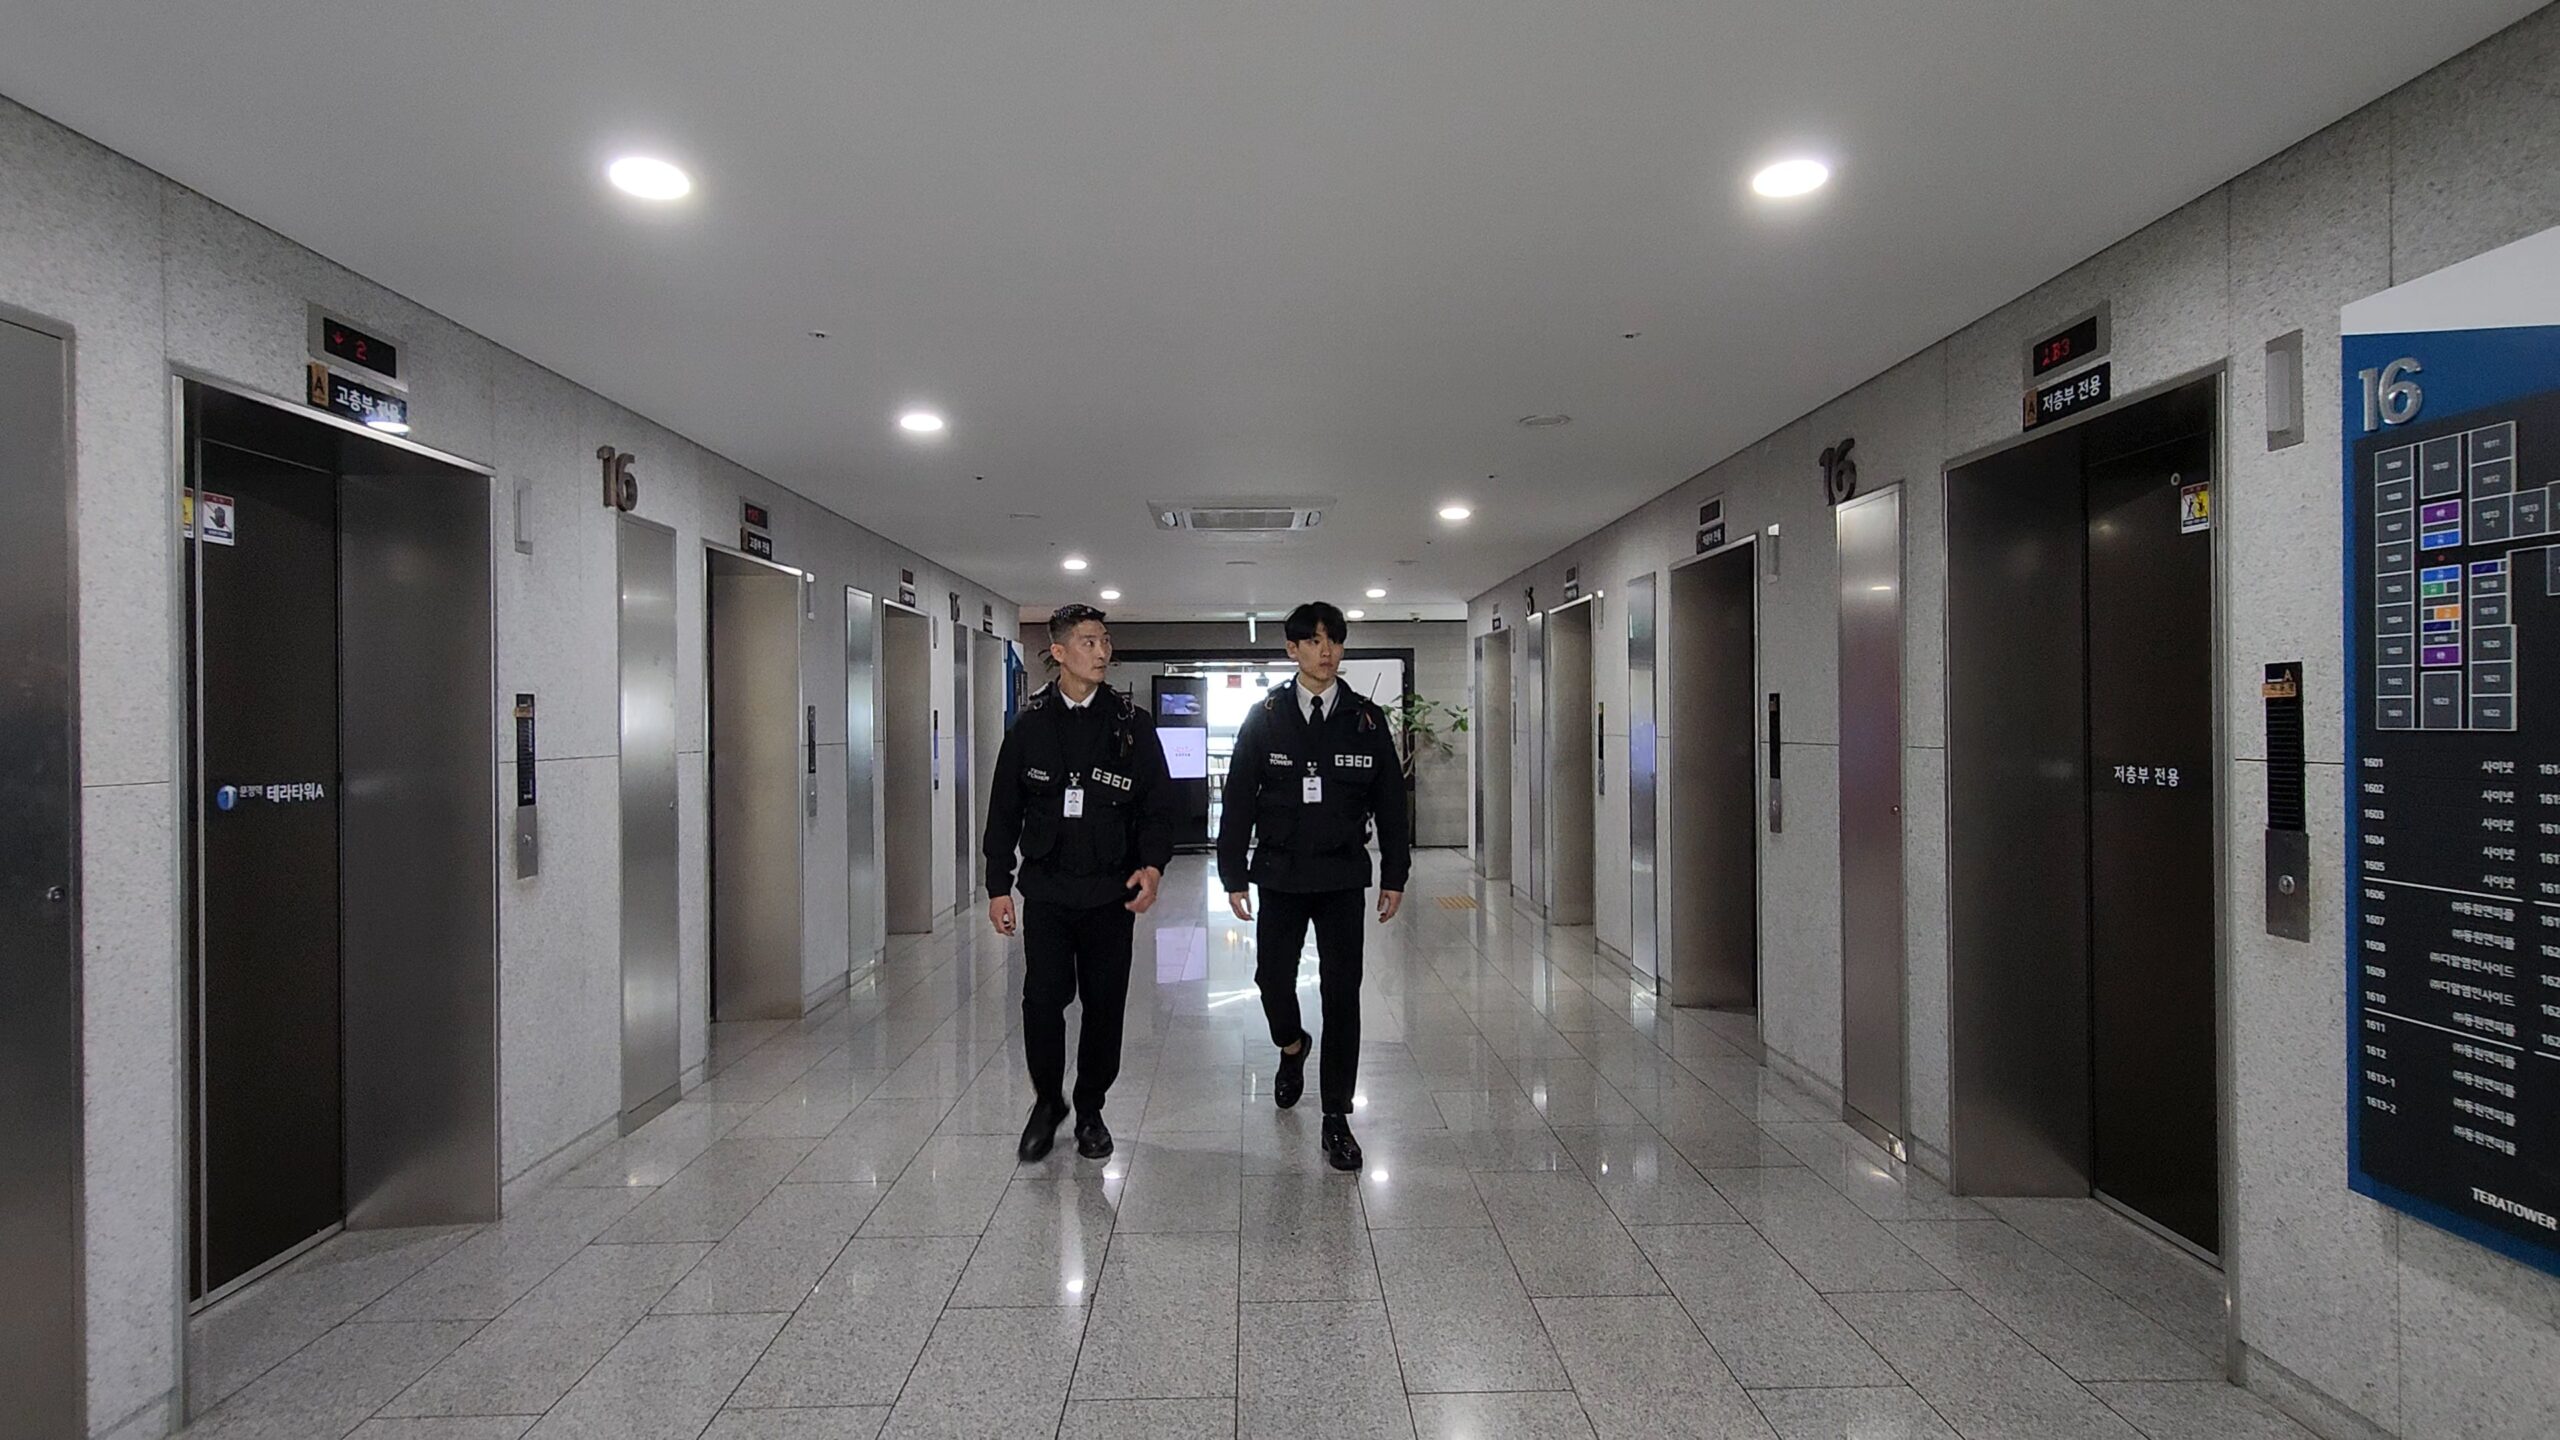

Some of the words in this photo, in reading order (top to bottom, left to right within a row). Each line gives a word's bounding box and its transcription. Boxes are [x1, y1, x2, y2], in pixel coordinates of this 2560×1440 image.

[356, 340, 368, 361] 2
[314, 376, 325, 396] A
[335, 385, 373, 415] 고층부
[2042, 385, 2075, 413] 저층부
[2077, 375, 2101, 401] 전용
[2358, 357, 2424, 432] 16
[2027, 401, 2036, 415] A
[597, 445, 638, 512] 16
[1819, 438, 1857, 507] 16
[1335, 754, 1373, 768] G360
[2363, 758, 2383, 767] 1601
[2482, 761, 2514, 773] 사이넷
[2539, 764, 2560, 774] 161
[1091, 767, 1132, 791] G360
[2113, 765, 2149, 784] 저층부
[2155, 767, 2179, 787] 전용
[266, 782, 324, 803] 테라타워A
[2364, 784, 2384, 793] 1602
[2482, 790, 2514, 803] 사이넷
[2539, 794, 2560, 804] 161
[2364, 809, 2384, 819] 1603
[2482, 818, 2514, 832] 사이넷
[2539, 824, 2560, 834] 161
[2365, 835, 2384, 845] 1604
[2483, 847, 2515, 861] 사이넷
[2540, 853, 2560, 864] 161
[2364, 860, 2385, 871] 1605
[2483, 875, 2515, 889] 사이넷
[2540, 883, 2560, 894] 161
[2365, 889, 2385, 900] 1606
[2365, 915, 2385, 925] 1607
[2541, 915, 2560, 927] 161
[2365, 940, 2385, 952] 1608
[2366, 965, 2385, 977] 1609
[2366, 991, 2386, 1003] 1610
[2366, 1020, 2385, 1032] 1611
[2366, 1045, 2386, 1059] 1612
[2366, 1071, 2395, 1087] 1613-1
[2366, 1096, 2396, 1114] 1613-2
[2471, 1187, 2558, 1231] TERATOWER
